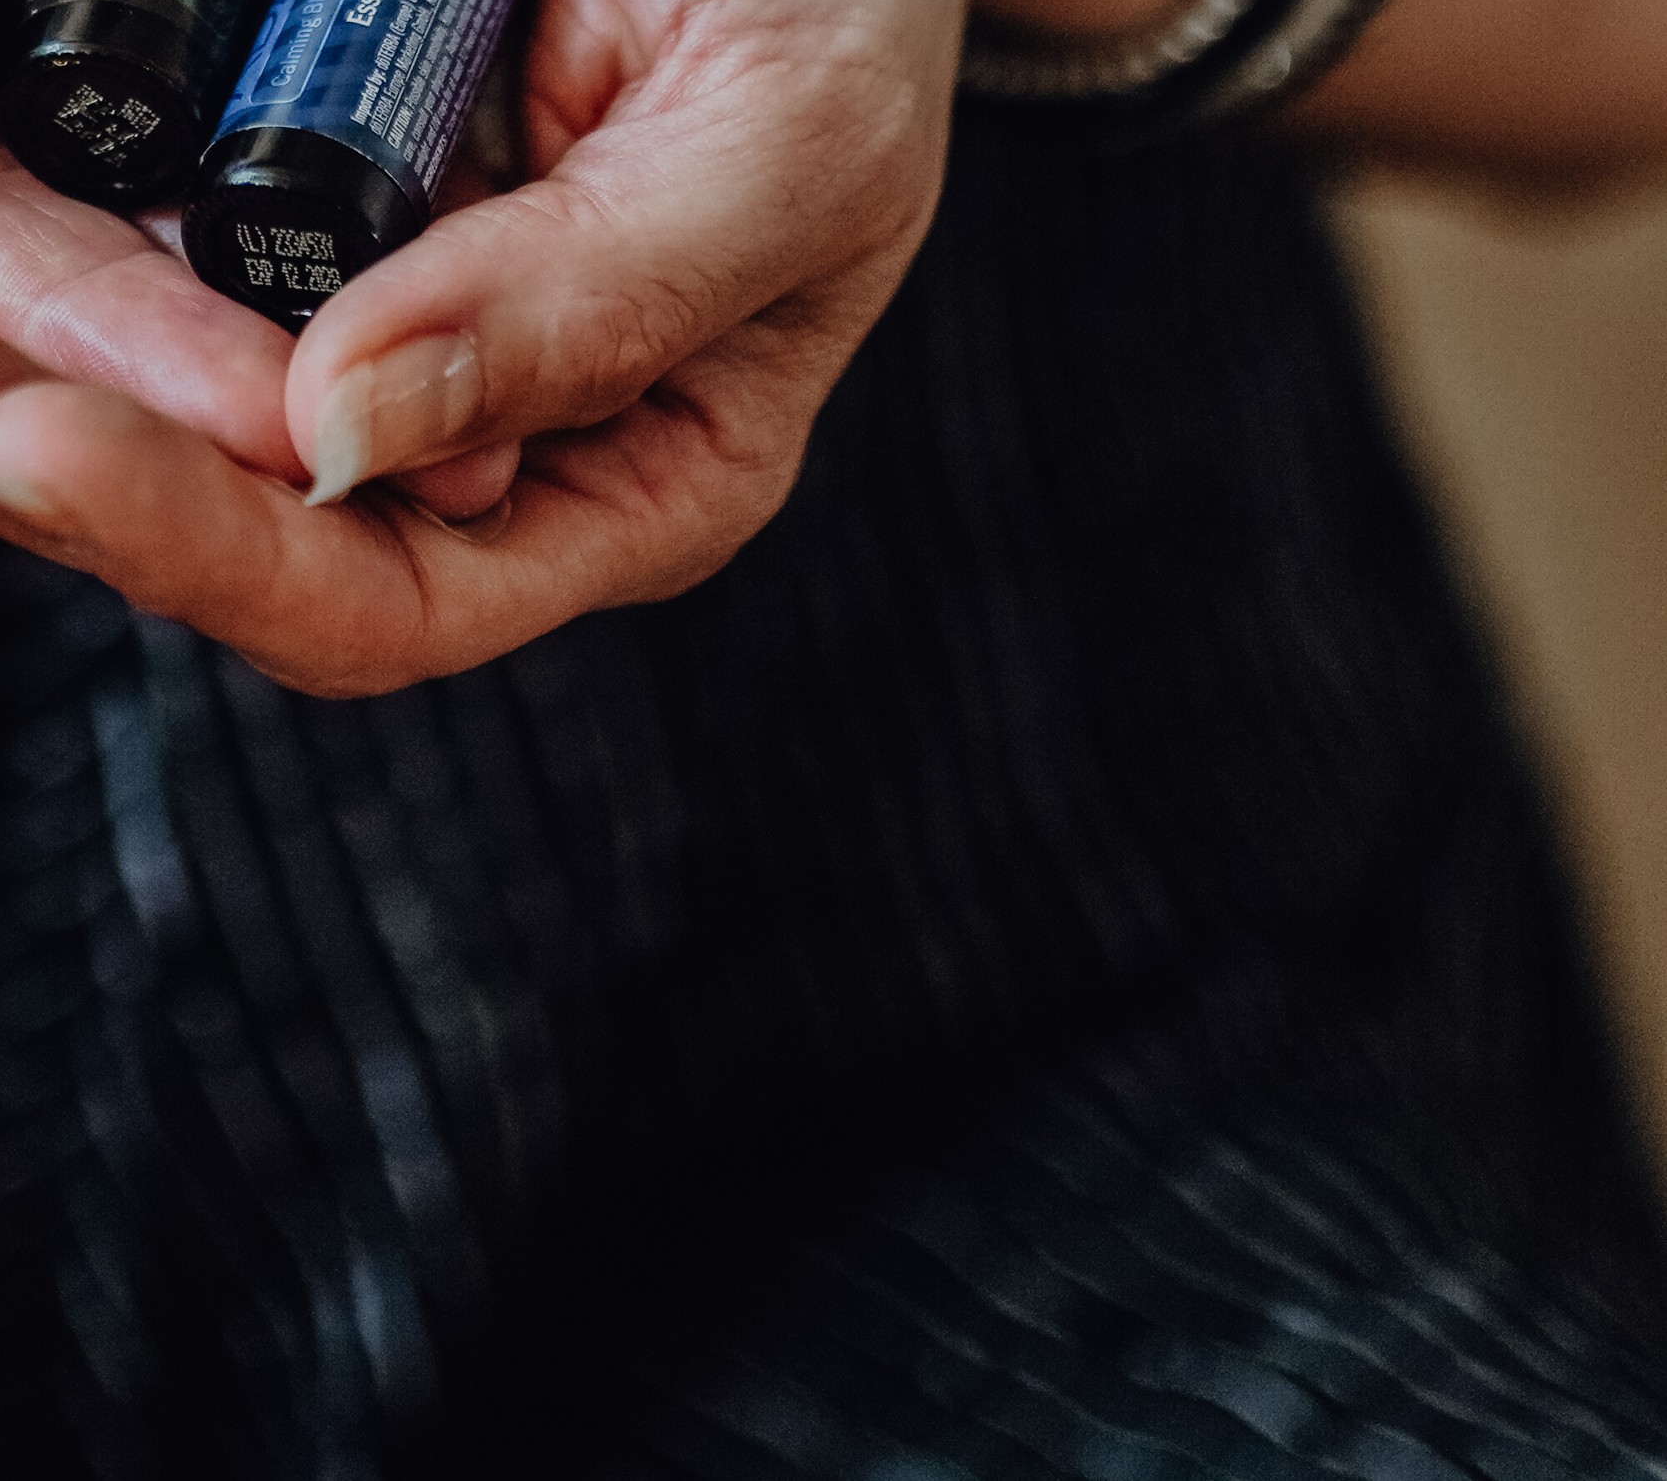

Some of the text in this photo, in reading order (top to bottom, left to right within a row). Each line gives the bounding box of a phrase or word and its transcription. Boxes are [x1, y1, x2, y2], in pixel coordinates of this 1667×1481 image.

[270, 14, 321, 85] Calming
[349, 82, 379, 125] Imported
[366, 68, 386, 85] by:
[388, 0, 417, 36] (Europe)
[383, 67, 405, 99] Europe
[395, 29, 423, 72] Marketing
[385, 104, 413, 149] CAUTION:
[238, 223, 266, 253] (L)
[244, 258, 274, 285] EXP
